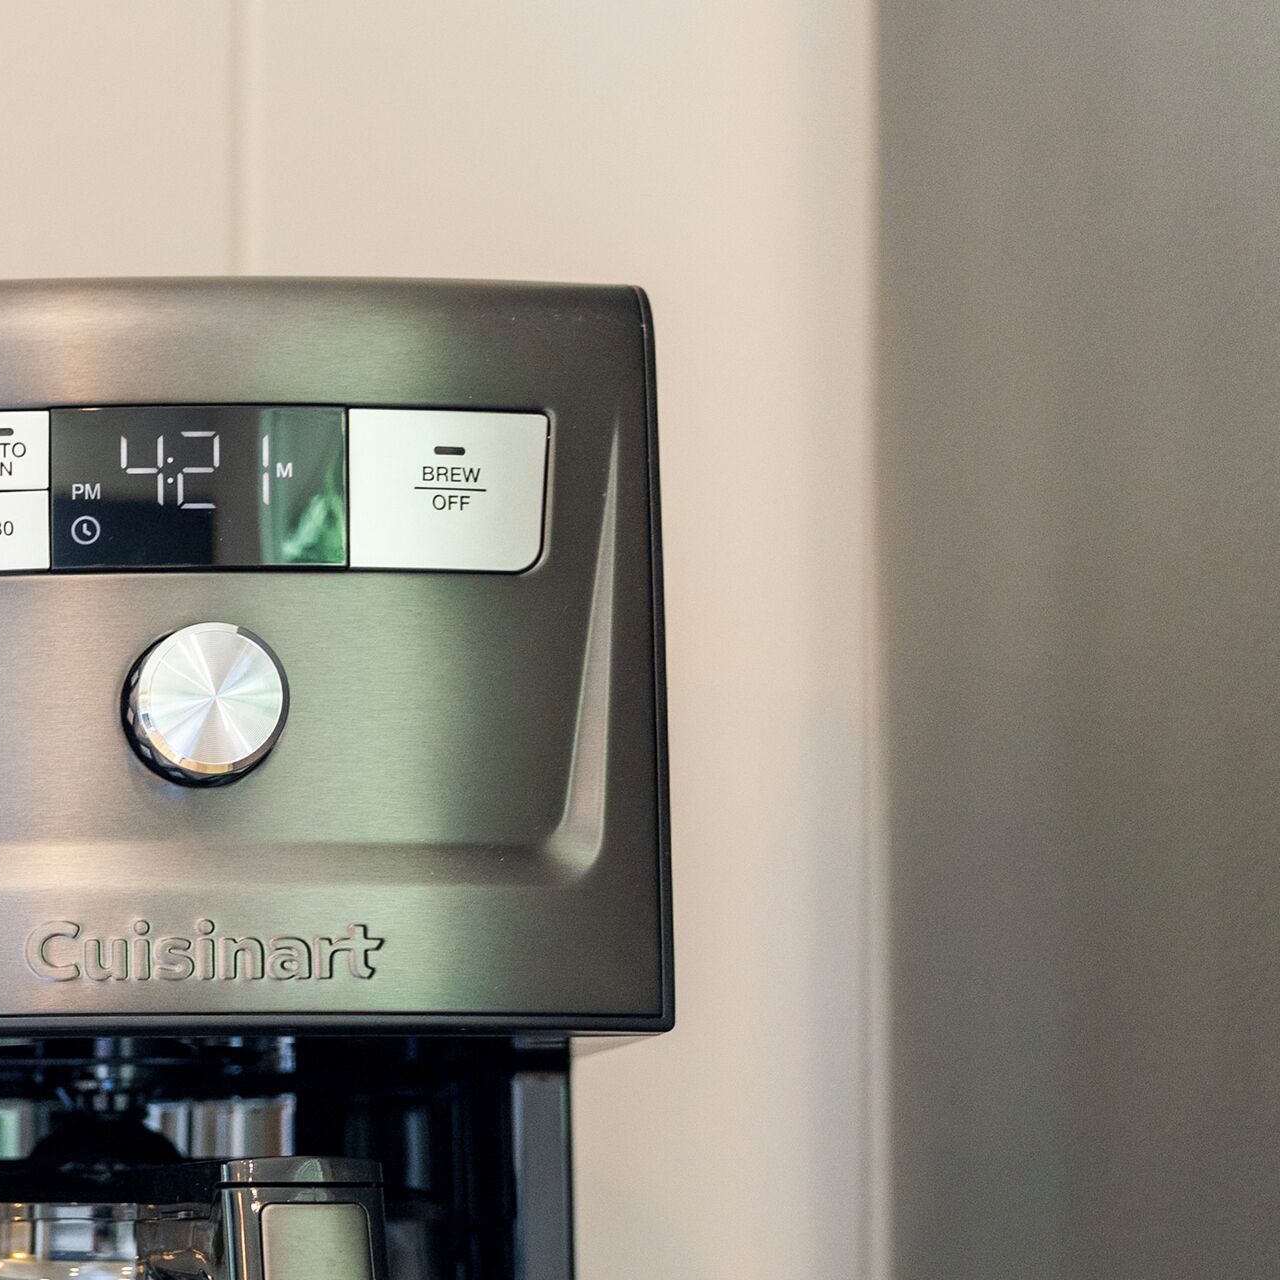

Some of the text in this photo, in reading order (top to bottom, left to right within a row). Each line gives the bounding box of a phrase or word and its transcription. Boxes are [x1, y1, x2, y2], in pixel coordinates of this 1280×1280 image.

[421, 466, 482, 484] BREW
[71, 484, 102, 500] PM
[431, 494, 472, 512] OFF
[24, 919, 385, 982] Cuisinart
